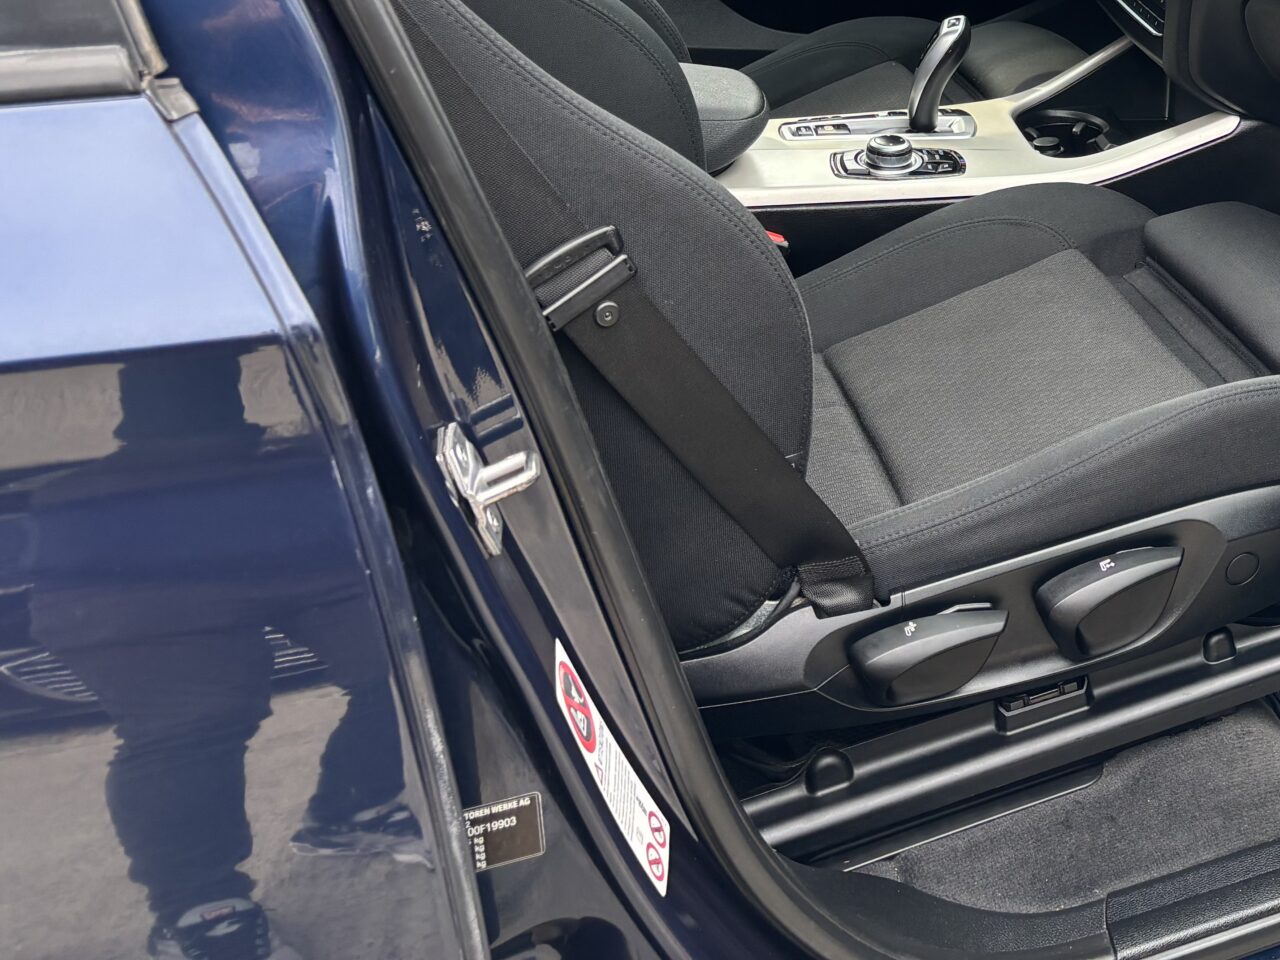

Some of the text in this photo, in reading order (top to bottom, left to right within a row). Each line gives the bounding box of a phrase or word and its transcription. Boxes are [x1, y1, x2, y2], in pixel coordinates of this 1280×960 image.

[463, 797, 530, 820] TOREN WERKE AG
[467, 816, 517, 837] 00F19903
[473, 836, 484, 845] kg
[474, 844, 485, 853] kg
[475, 852, 486, 861] kg
[476, 860, 487, 869] kg
